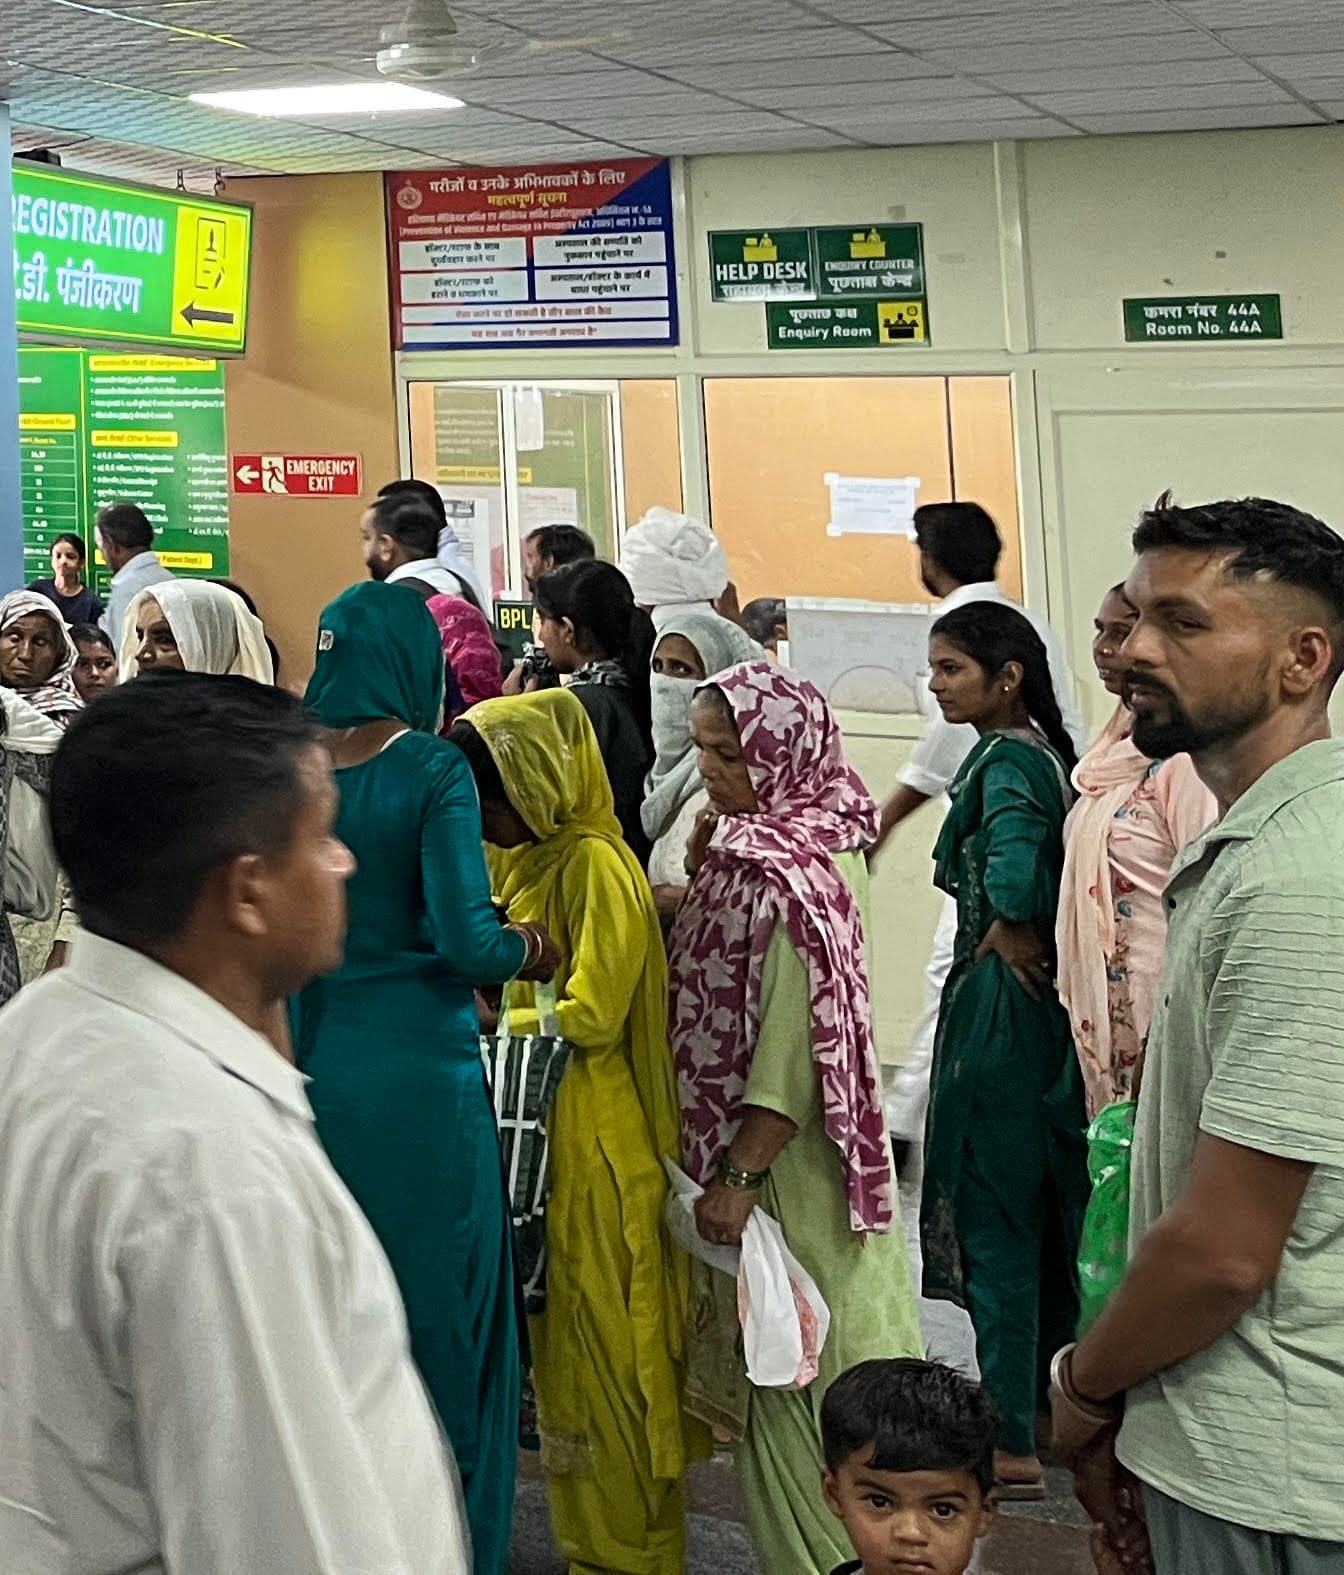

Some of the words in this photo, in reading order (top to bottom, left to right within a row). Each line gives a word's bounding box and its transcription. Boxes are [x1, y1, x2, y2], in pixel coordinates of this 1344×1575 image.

[716, 263, 759, 281] HELP
[763, 261, 808, 279] DESK
[869, 259, 914, 270] COUNTER
[56, 256, 143, 313] पंजीकरण
[1143, 306, 1182, 319] कमरा
[1185, 302, 1217, 318] नंबर
[1227, 303, 1260, 316] 44A
[778, 326, 830, 341] Enquiry
[833, 325, 872, 337] Room
[1145, 322, 1192, 336] Room
[1198, 320, 1224, 335] No.
[1229, 320, 1262, 333] 44A
[286, 460, 355, 475] EMERGENCY
[308, 476, 334, 491] EXIT
[500, 608, 531, 629] BPL
